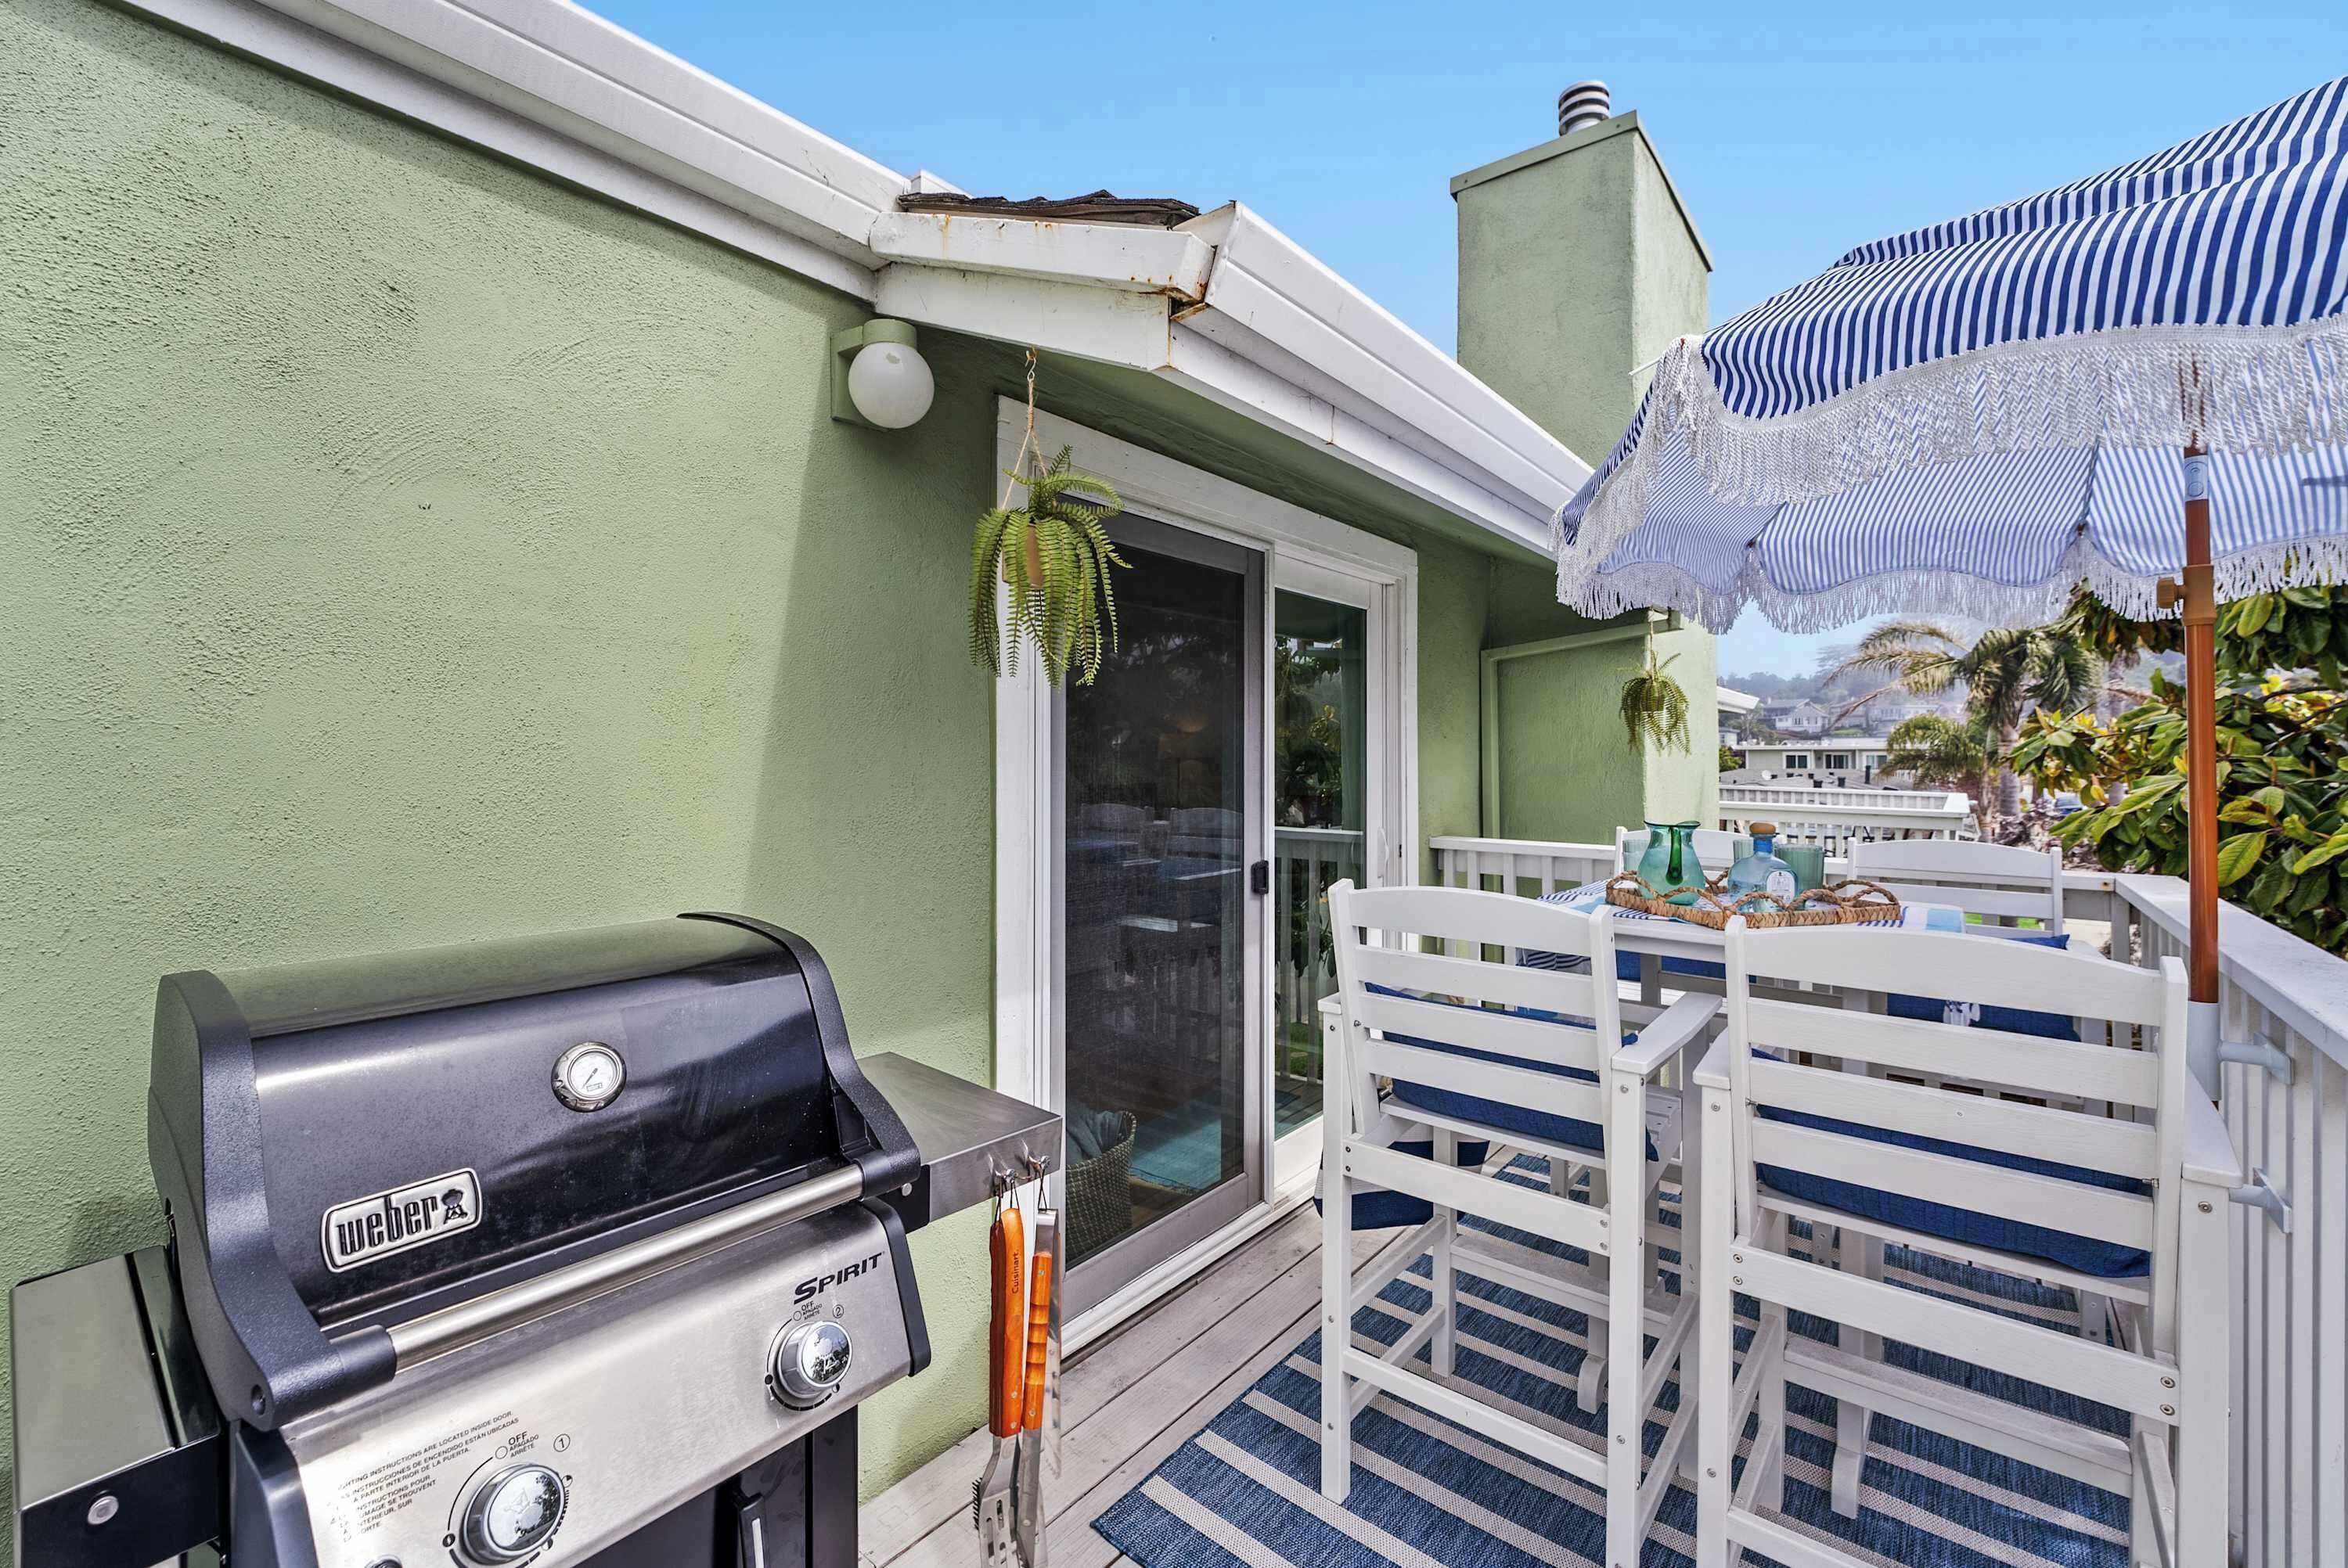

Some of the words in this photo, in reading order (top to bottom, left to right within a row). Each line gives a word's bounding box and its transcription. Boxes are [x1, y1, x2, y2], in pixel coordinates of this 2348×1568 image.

[337, 1194, 438, 1256] weber
[793, 1252, 882, 1305] SPIRIT
[801, 1300, 815, 1311] OFF
[369, 1451, 423, 1477] INSTRUCTIONS
[423, 1442, 438, 1454] ARE
[438, 1430, 470, 1447] LOCATED
[470, 1419, 491, 1433] INSIDE
[509, 1430, 528, 1446] OFF
[509, 1434, 539, 1452] APAGADO
[352, 1465, 412, 1495] INSTRUCCIONES
[412, 1460, 423, 1469] DE
[424, 1442, 464, 1465] ENCENDIDO
[487, 1417, 520, 1436] UBICADAS
[361, 1484, 385, 1500] PARTE
[385, 1469, 420, 1490] INTERIOR
[421, 1465, 431, 1473] DE
[432, 1458, 441, 1468] LA
[387, 1498, 397, 1506] SE
[398, 1479, 436, 1501] TROUVENT
[409, 1473, 430, 1487] POUR
[398, 1498, 413, 1509] SUR
